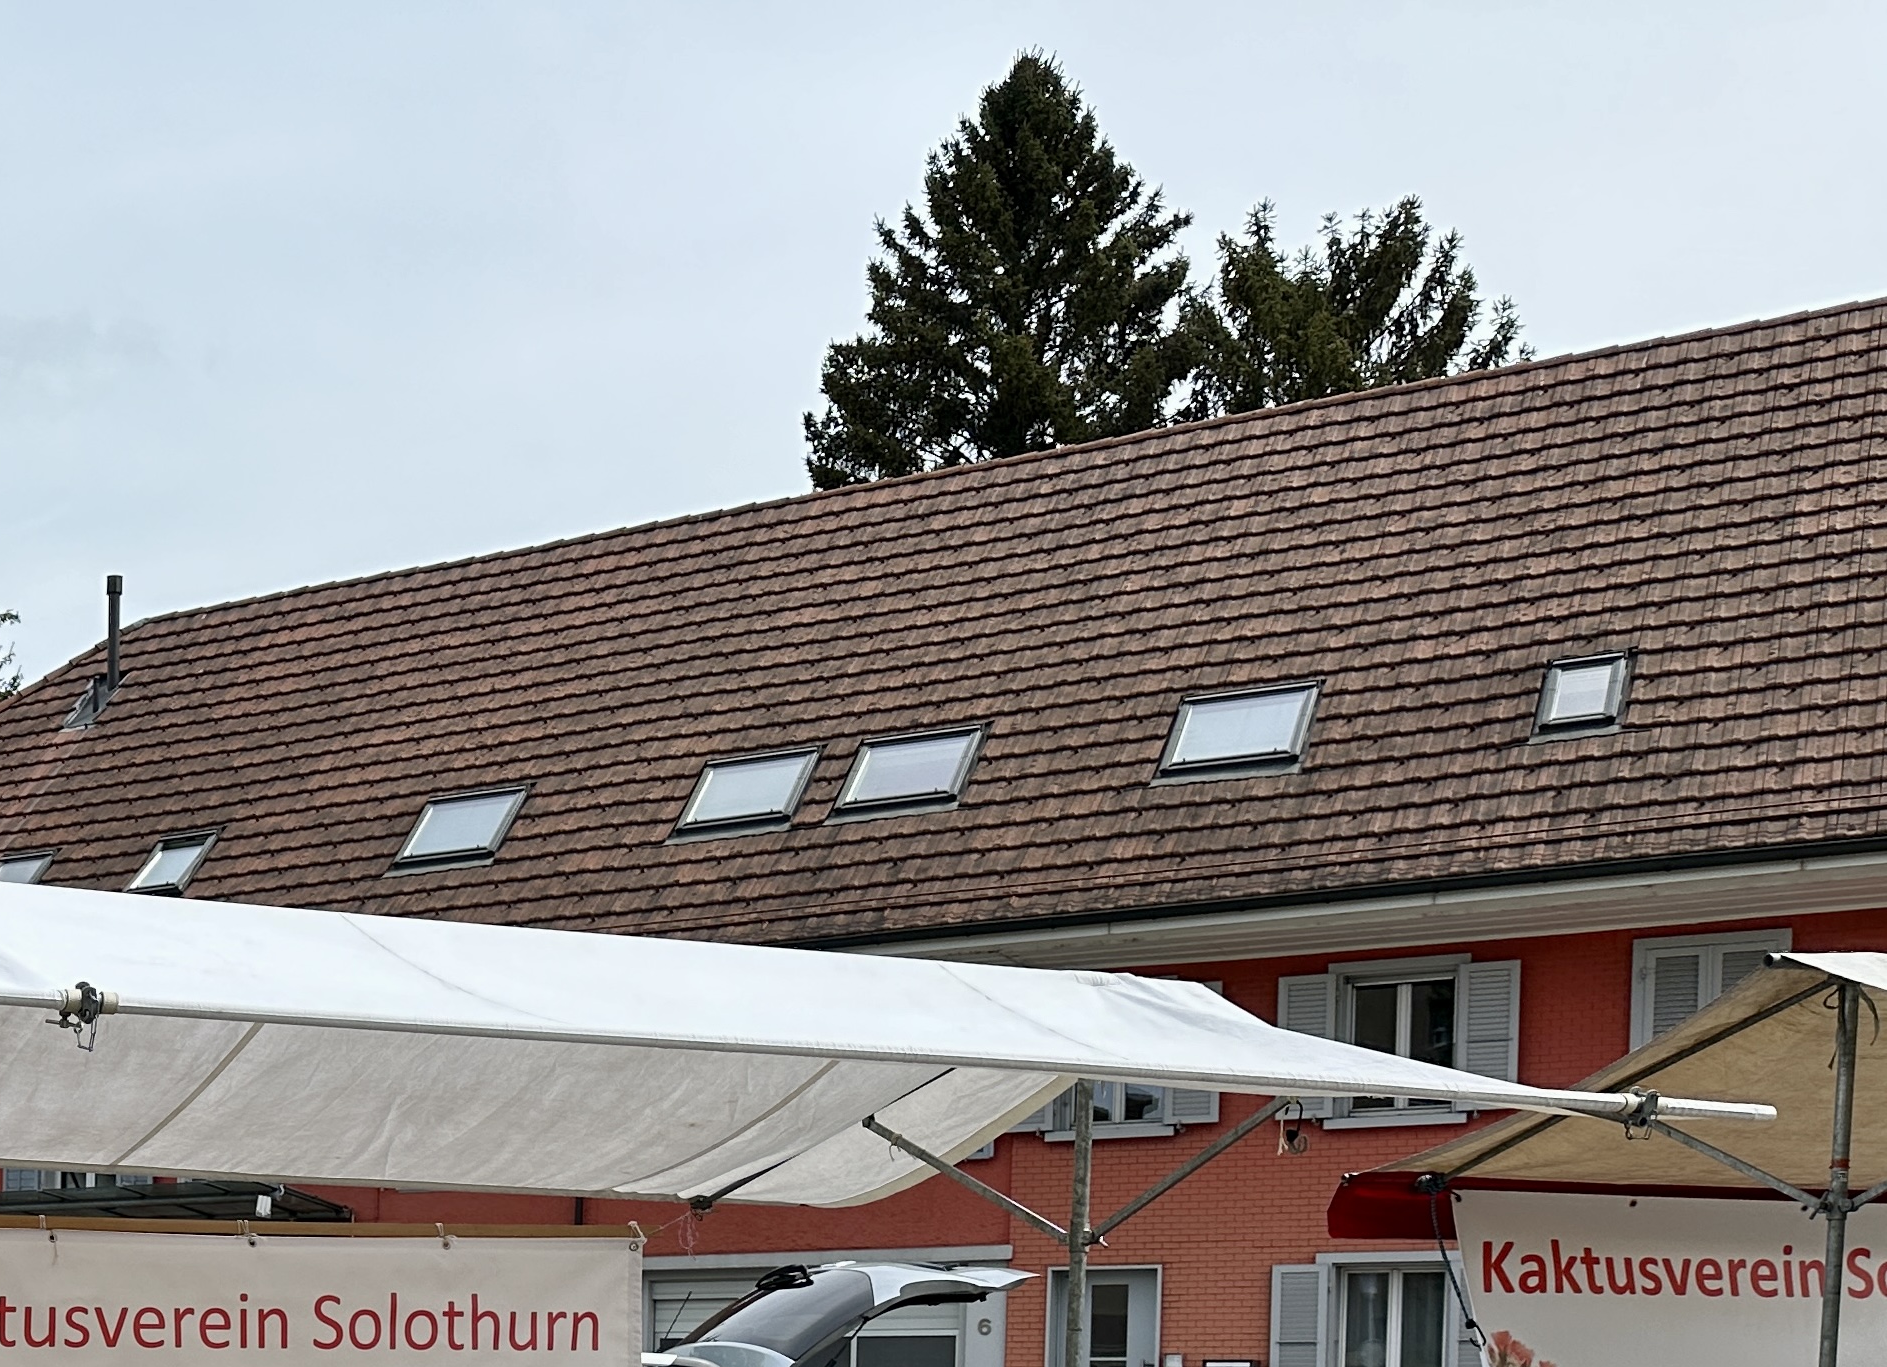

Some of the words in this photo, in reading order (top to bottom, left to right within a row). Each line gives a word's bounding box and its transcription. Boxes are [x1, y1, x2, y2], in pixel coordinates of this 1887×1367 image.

[1481, 1239, 1826, 1299] Kaktusverein
[312, 1292, 600, 1352] Solothurn
[977, 1318, 992, 1336] 6
